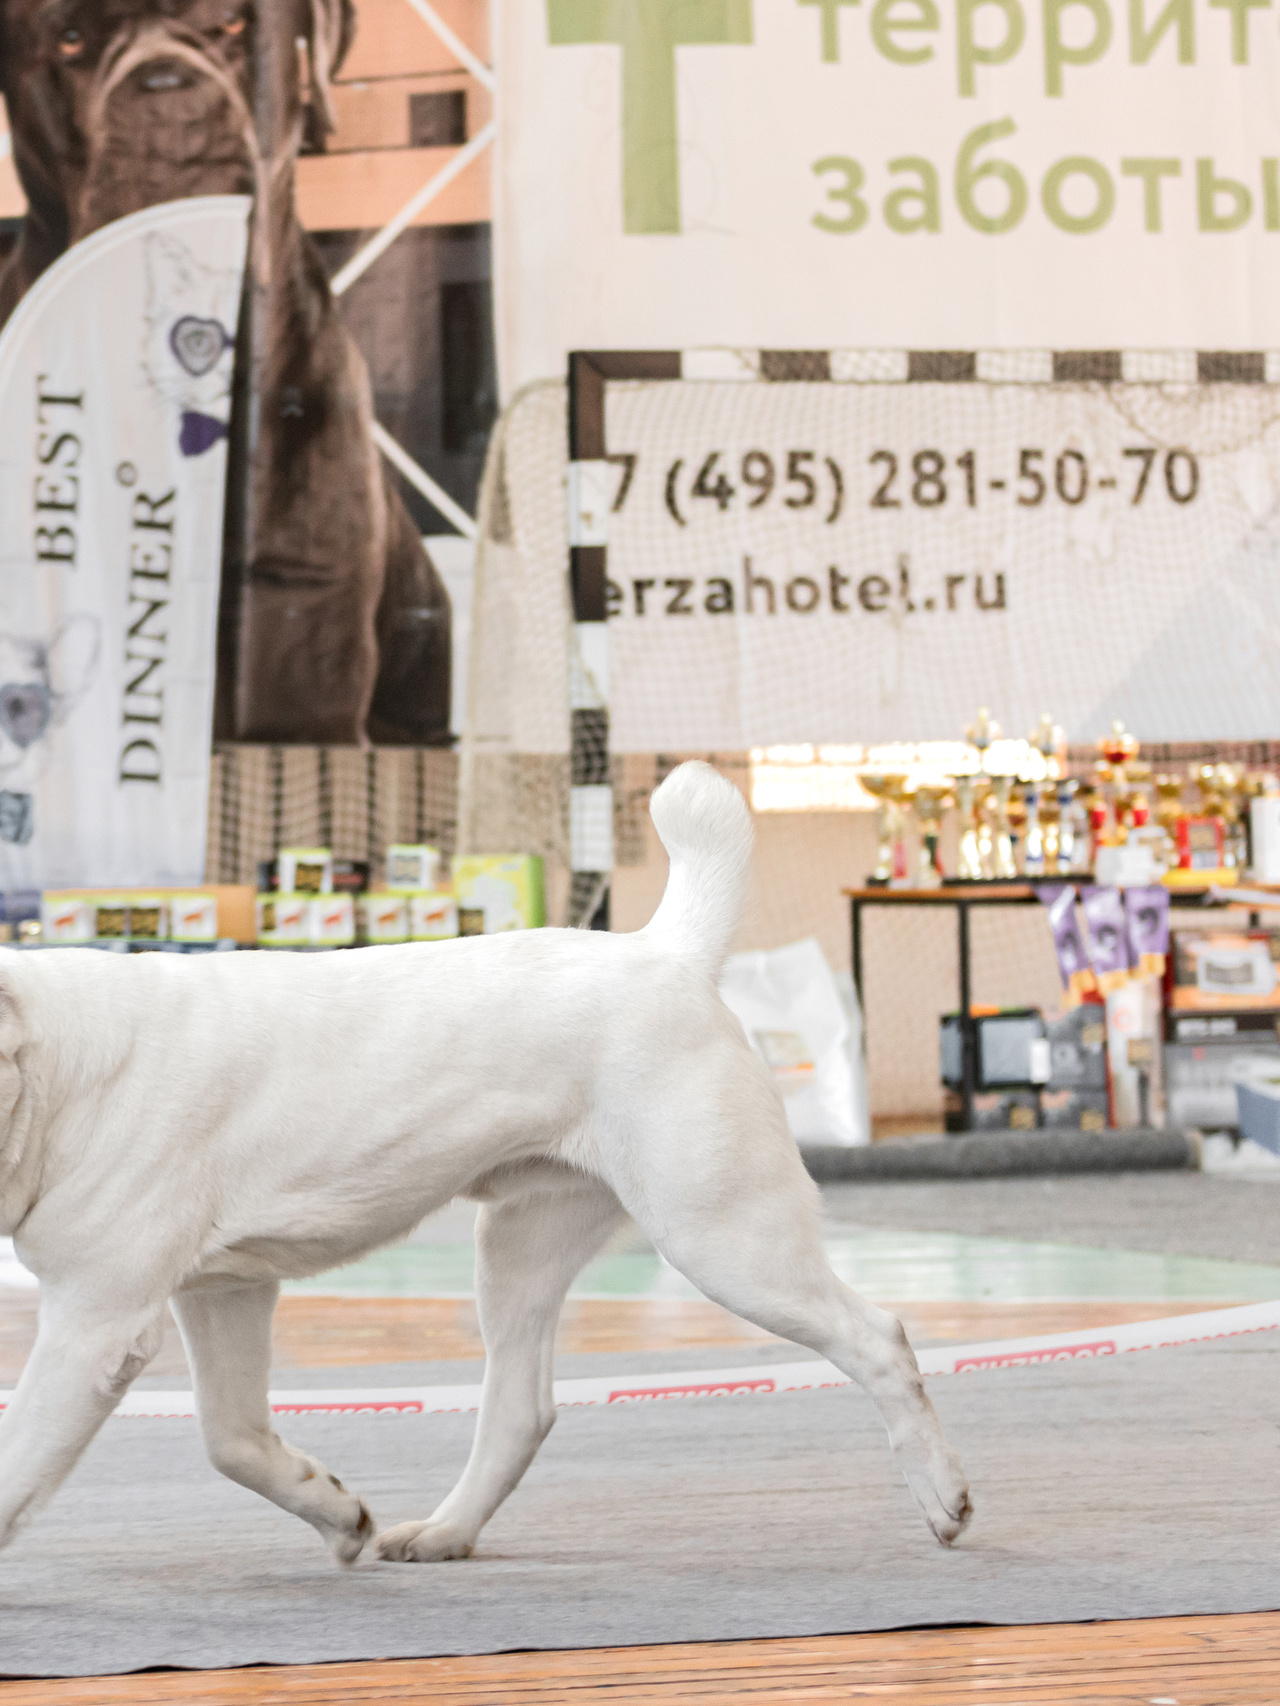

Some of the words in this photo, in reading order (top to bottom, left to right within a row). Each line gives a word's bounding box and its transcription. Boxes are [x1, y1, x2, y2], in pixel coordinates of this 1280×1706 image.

[797, 0, 1280, 98] террит
[810, 115, 1280, 236] заботы
[34, 373, 85, 566] BEST
[664, 450, 844, 527] (495)
[868, 447, 1201, 510] 281-50-70
[121, 486, 177, 787] DINNER
